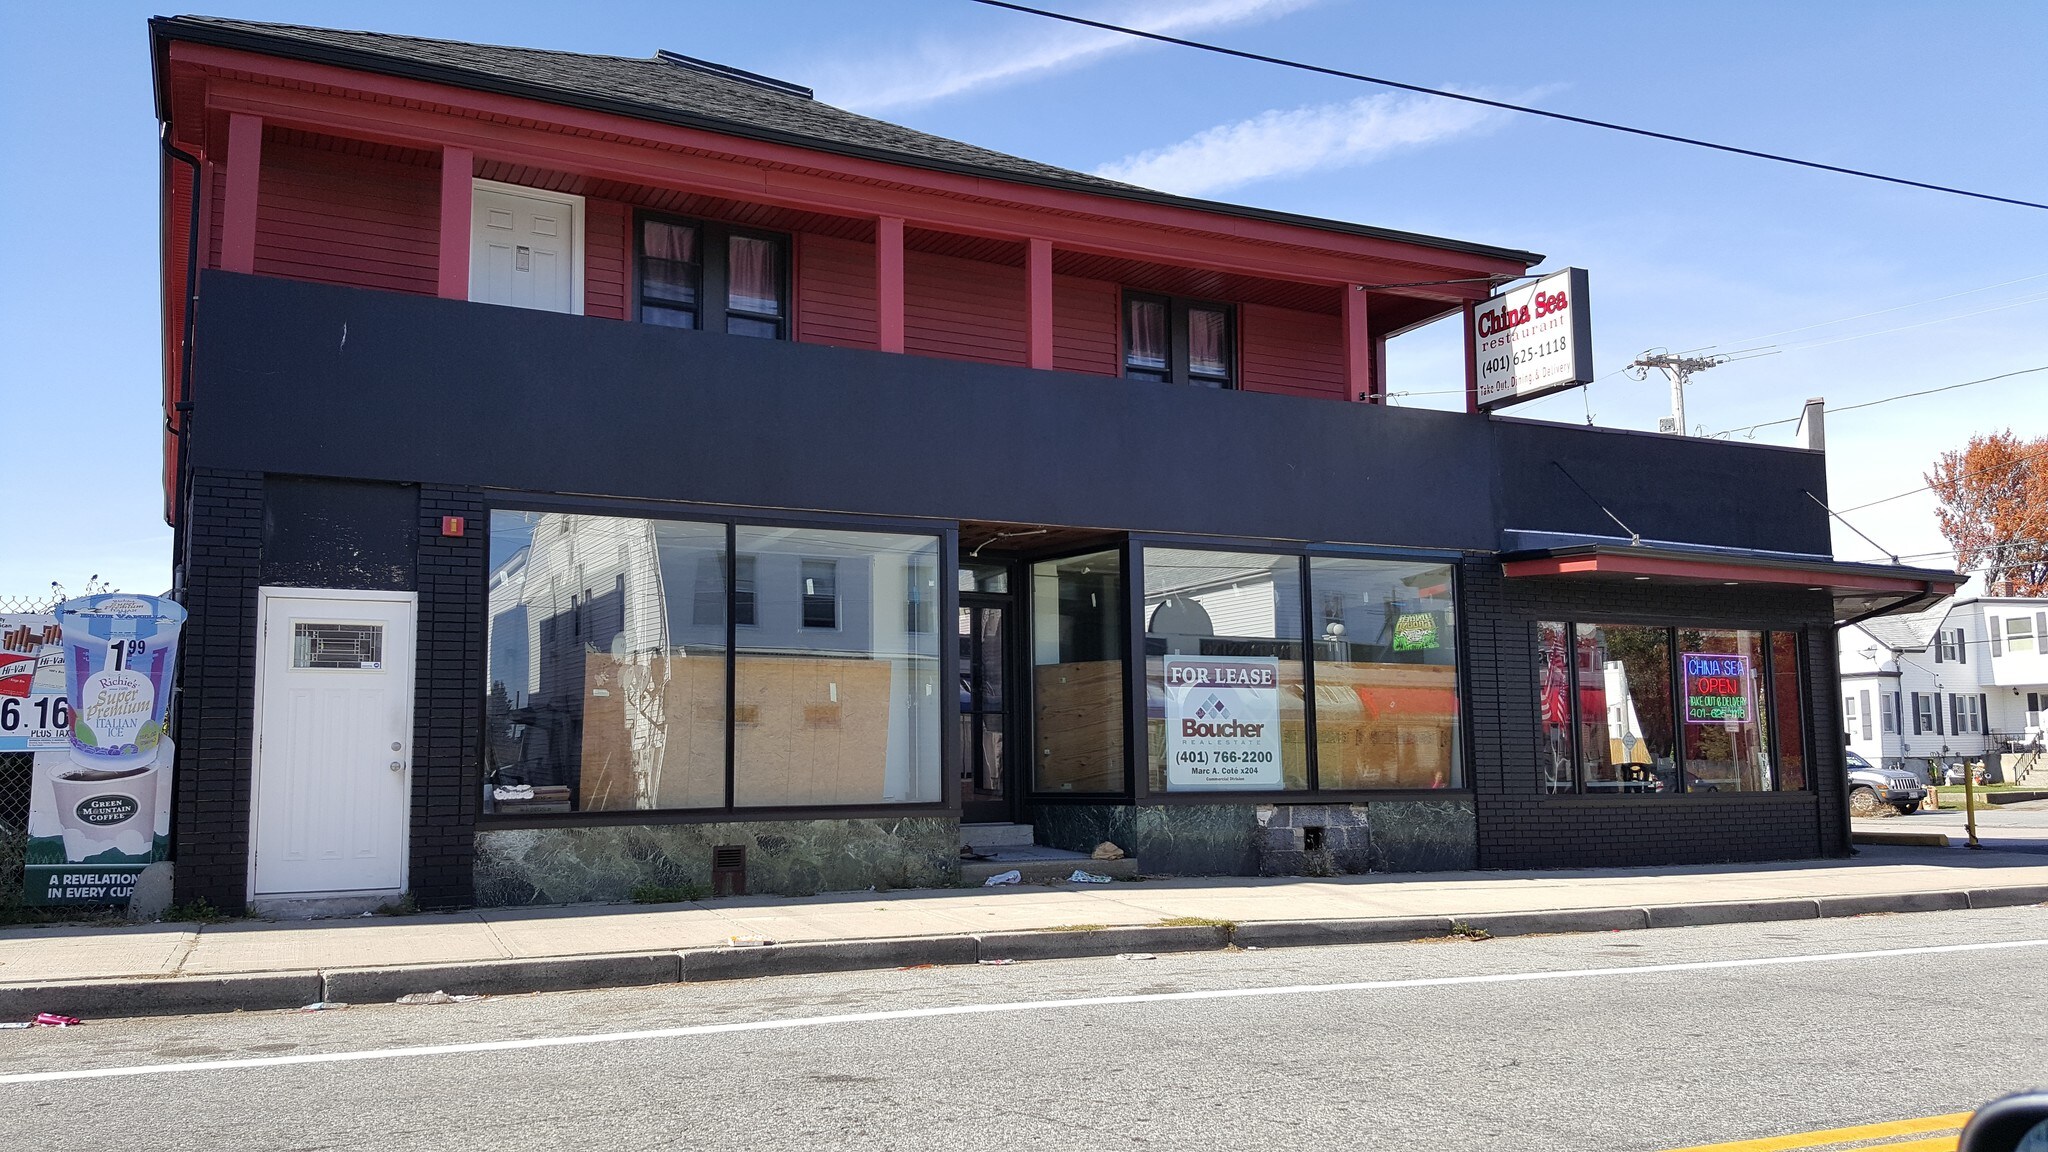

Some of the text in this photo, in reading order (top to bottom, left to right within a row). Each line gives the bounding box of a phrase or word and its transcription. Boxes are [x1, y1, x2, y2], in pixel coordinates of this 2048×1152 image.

[1478, 290, 1568, 339] China Sea
[1482, 315, 1565, 352] restaurant
[1482, 336, 1567, 379] (401) 625-1118
[1480, 383, 1494, 397] Take
[1542, 361, 1571, 378] Delivery
[128, 640, 146, 655] 99
[2, 664, 27, 676] Hi-Val
[1688, 659, 1745, 676] CHINA SEA
[98, 675, 138, 689] Richie's
[1171, 667, 1273, 686] FOR LEASE
[1698, 677, 1738, 694] OPEN
[97, 689, 139, 707] Super
[1689, 696, 1703, 706] TAKE
[1704, 696, 1716, 706] OUT
[1722, 696, 1747, 707] DELIVERY
[1, 696, 68, 732] 6.16
[86, 700, 151, 722] Premium
[95, 718, 138, 729] ITALIAN
[1182, 718, 1265, 738] Boucher
[31, 729, 70, 738] PLUS TAX
[107, 728, 124, 737] ICE
[1175, 751, 1273, 766] (401) 766-2200
[1191, 766, 1258, 775] Marc A. Coté x204
[82, 805, 131, 815] MOUNTAIN
[91, 799, 122, 808] GREEN
[89, 812, 125, 822] COFFEE
[49, 873, 140, 885] A REVELATION
[47, 886, 134, 899] IN EVERY CUP
